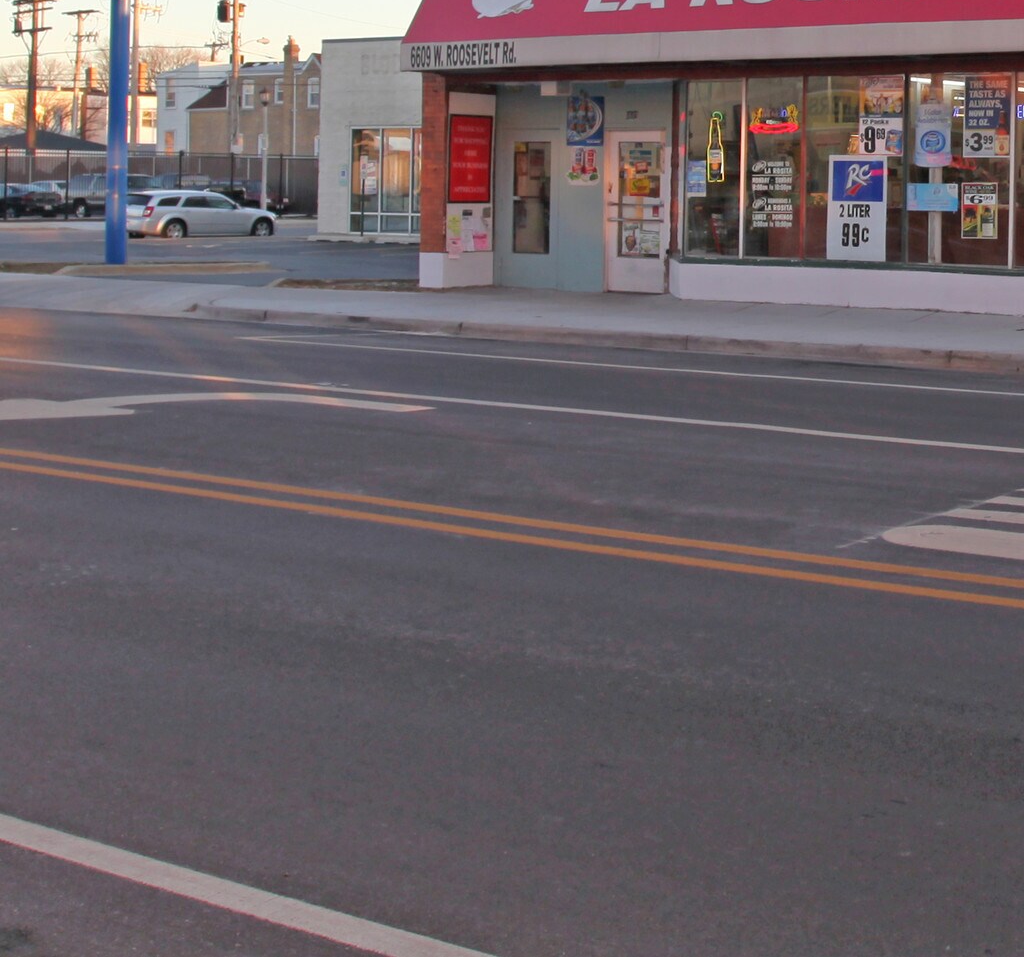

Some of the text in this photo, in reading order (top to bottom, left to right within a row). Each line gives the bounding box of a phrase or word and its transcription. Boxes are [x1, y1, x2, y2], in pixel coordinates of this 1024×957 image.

[410, 46, 431, 67] 6609
[433, 46, 444, 66] W.
[446, 42, 500, 66] ROOSEVELT
[502, 42, 517, 64] Rd.
[969, 80, 1008, 89] THE SAME
[969, 90, 1006, 98] TASTE AS
[968, 99, 1002, 110] ALWAYS,
[968, 109, 994, 118] NOW IN
[978, 118, 990, 126] OZ.
[846, 164, 872, 188] RC
[840, 204, 870, 218] 2 LITER
